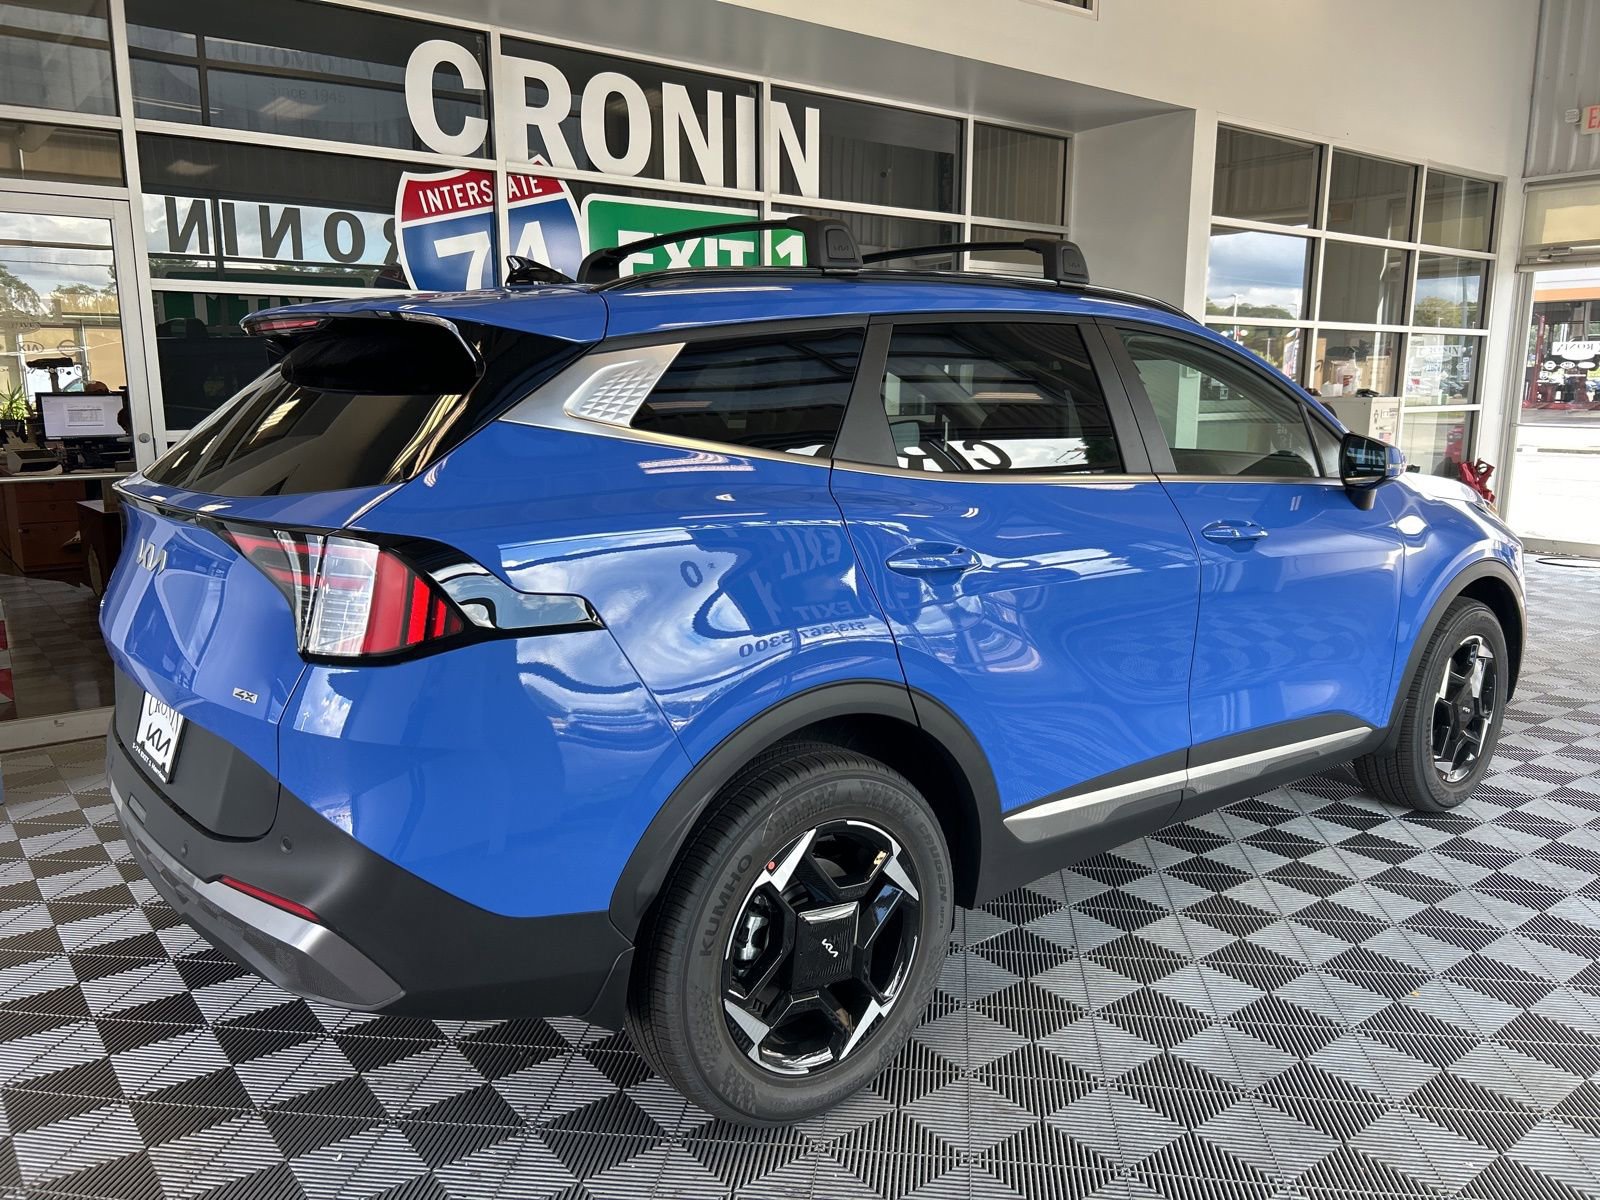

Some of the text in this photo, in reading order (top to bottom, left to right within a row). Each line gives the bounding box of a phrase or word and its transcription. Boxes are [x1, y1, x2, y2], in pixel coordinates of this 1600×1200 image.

[404, 39, 820, 199] CRONIN
[1588, 107, 1600, 129] E
[418, 174, 542, 213] INTERSATE
[136, 538, 167, 576] KIA
[146, 723, 171, 757] KIA
[700, 854, 753, 958] KUMHO
[821, 938, 839, 958] KIA
